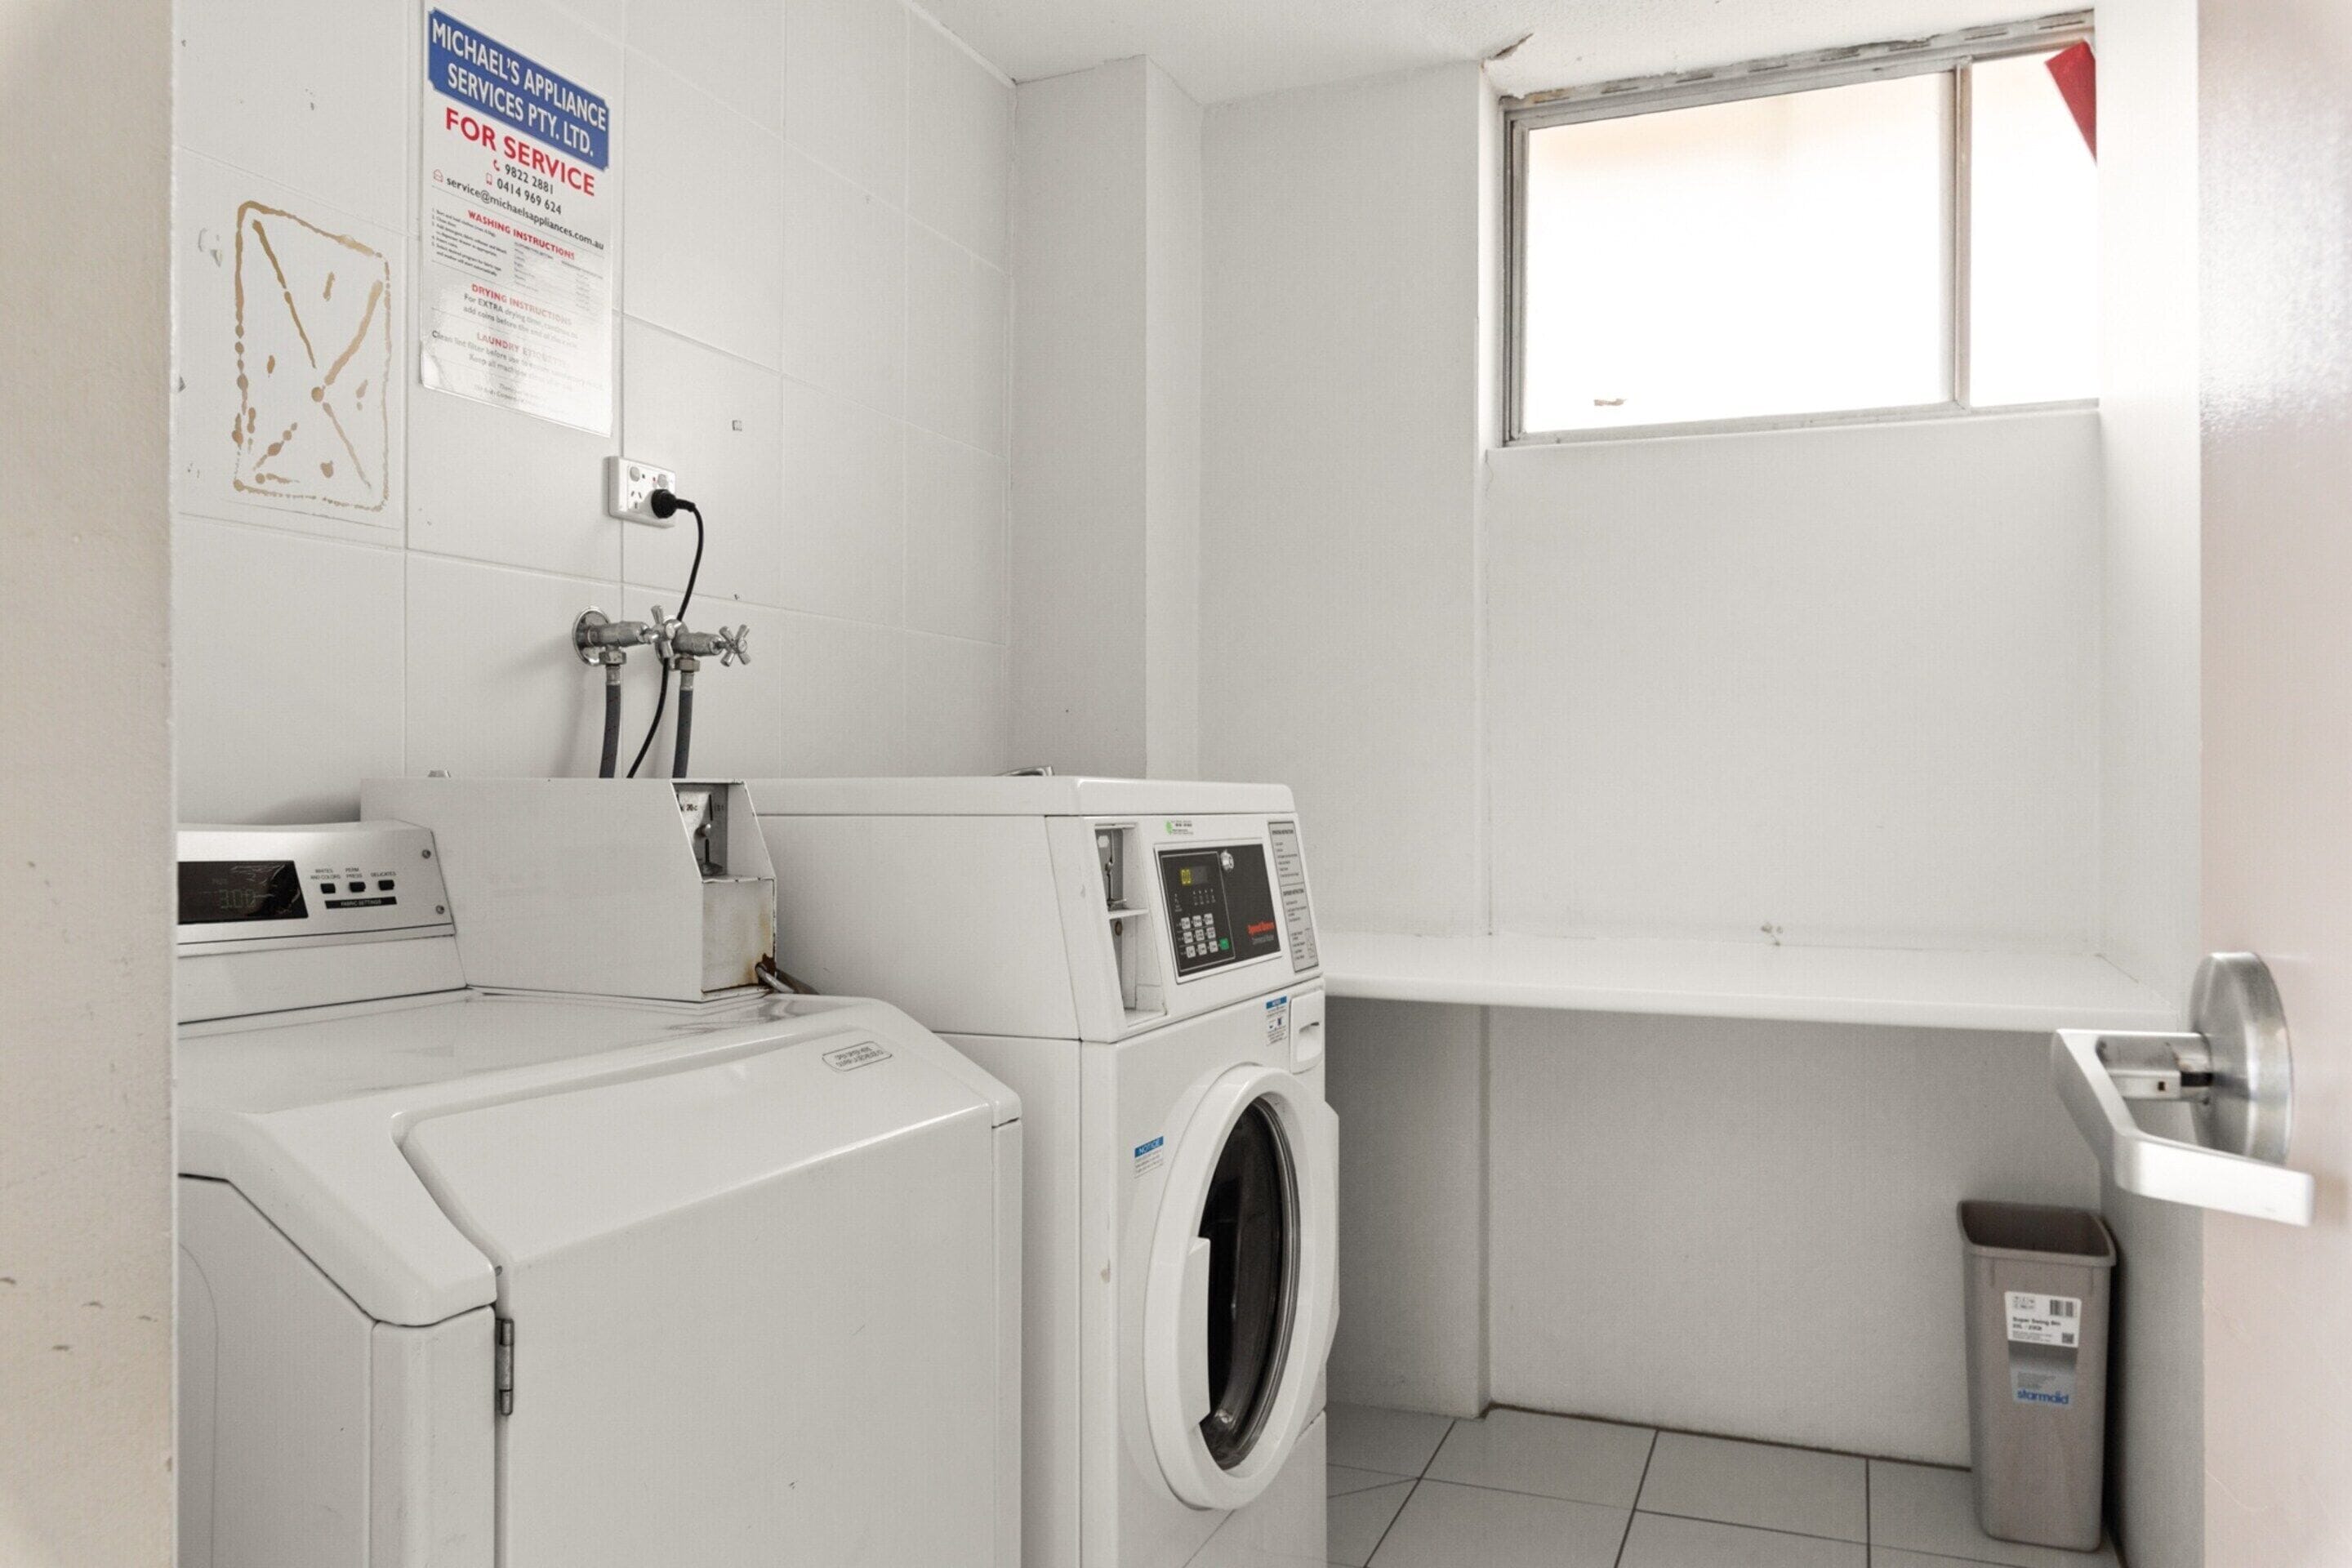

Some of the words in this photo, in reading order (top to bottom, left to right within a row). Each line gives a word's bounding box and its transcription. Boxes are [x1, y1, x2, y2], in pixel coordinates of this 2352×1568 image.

[432, 19, 519, 86] MICHAEL'S
[523, 69, 606, 131] APPLIANCE
[448, 63, 523, 121] SERVICES
[528, 104, 559, 140] PTY.
[564, 122, 594, 157] LTD.
[446, 107, 497, 151] FOR
[504, 136, 595, 197] SERVICE
[497, 178, 521, 198] 0414
[524, 192, 542, 207] 969
[544, 199, 562, 215] 624
[505, 165, 529, 184] 9822
[532, 176, 554, 195] 2881
[446, 178, 604, 251] service@michaelsappliances.com.au
[468, 210, 510, 234] WASHING
[513, 225, 575, 260] INSTRUCTIONS
[471, 283, 506, 304] DRYING
[509, 296, 572, 327] INSTRUCTIONS
[477, 297, 503, 314] EXTRA
[476, 331, 520, 354] LAUNDRY
[2017, 1388, 2069, 1405] starmaid
